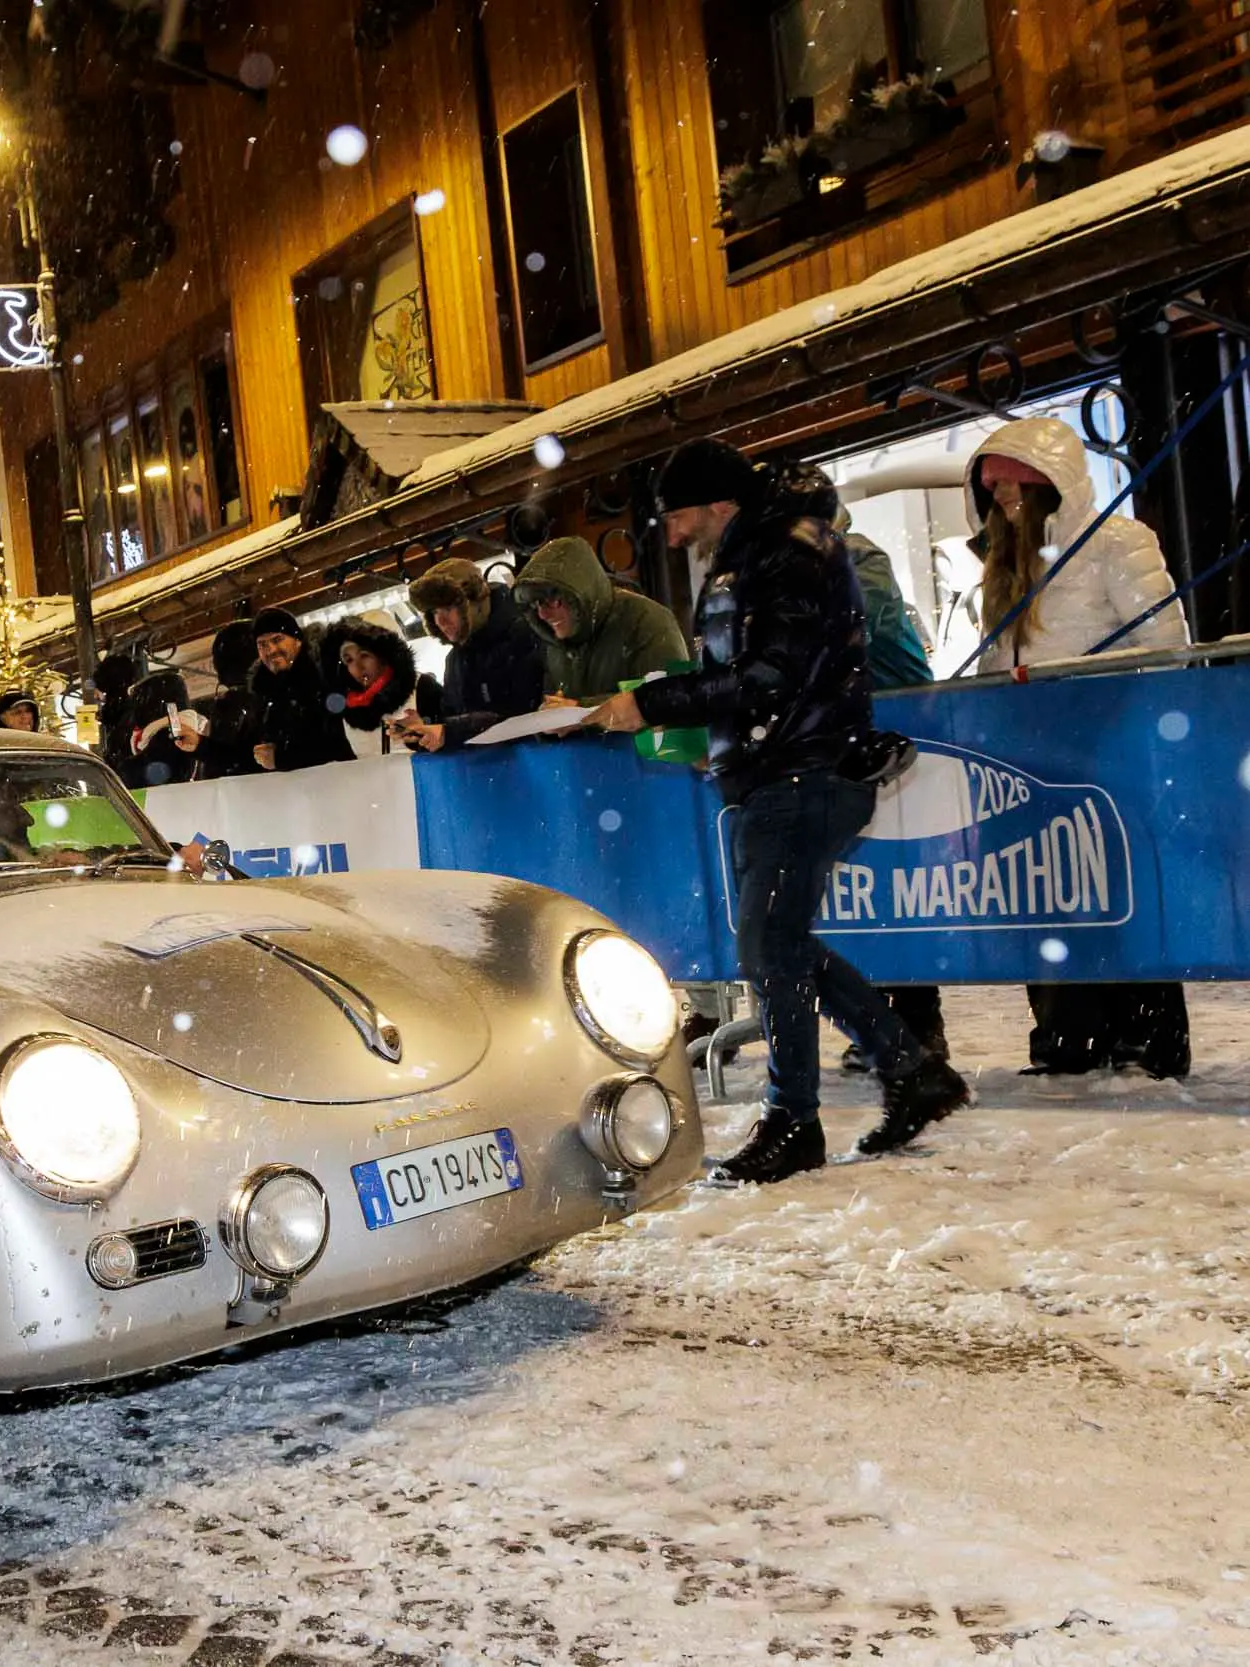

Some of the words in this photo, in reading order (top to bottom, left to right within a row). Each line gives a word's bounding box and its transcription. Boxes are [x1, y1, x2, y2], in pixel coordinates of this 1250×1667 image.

[968, 762, 1030, 822] 2026
[821, 862, 876, 920] ER
[893, 798, 1109, 919] MARATHON
